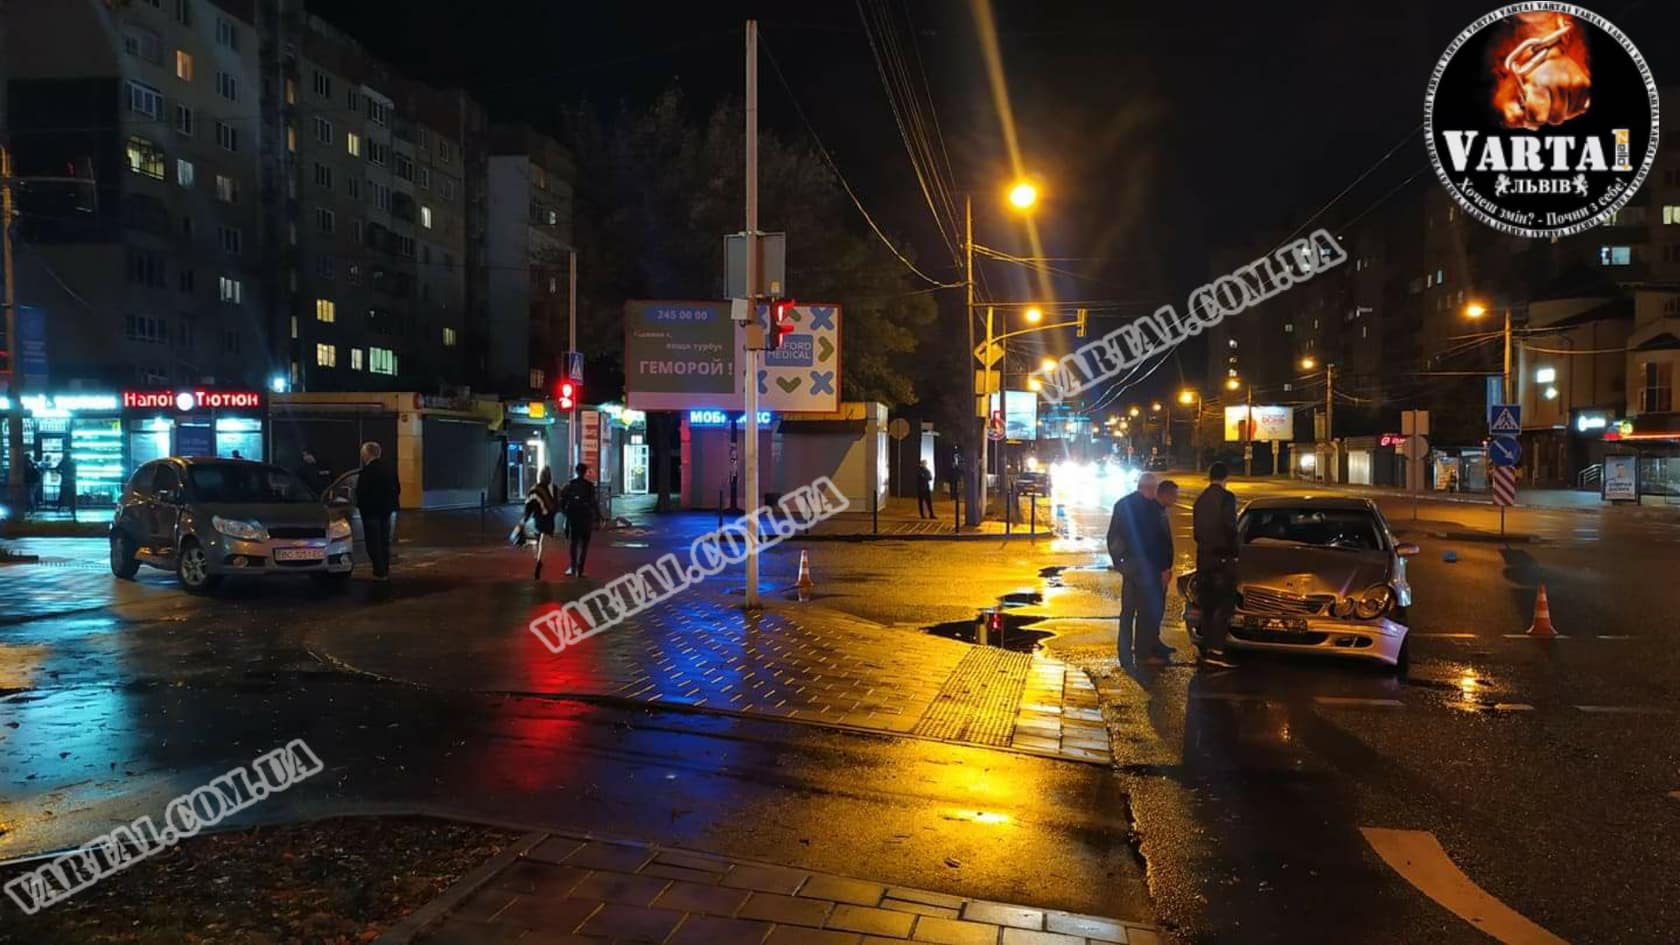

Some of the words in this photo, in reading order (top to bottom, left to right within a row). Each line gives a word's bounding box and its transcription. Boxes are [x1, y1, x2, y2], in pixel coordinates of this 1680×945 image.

[657, 310, 676, 319] 245
[679, 310, 692, 319] 00
[694, 310, 708, 320] 00
[767, 342, 811, 350] FORD
[767, 351, 811, 360] MEDICAL
[640, 358, 724, 374] ГЕМОРОЙ
[124, 391, 173, 407] Напої
[196, 391, 258, 407] Тютюн
